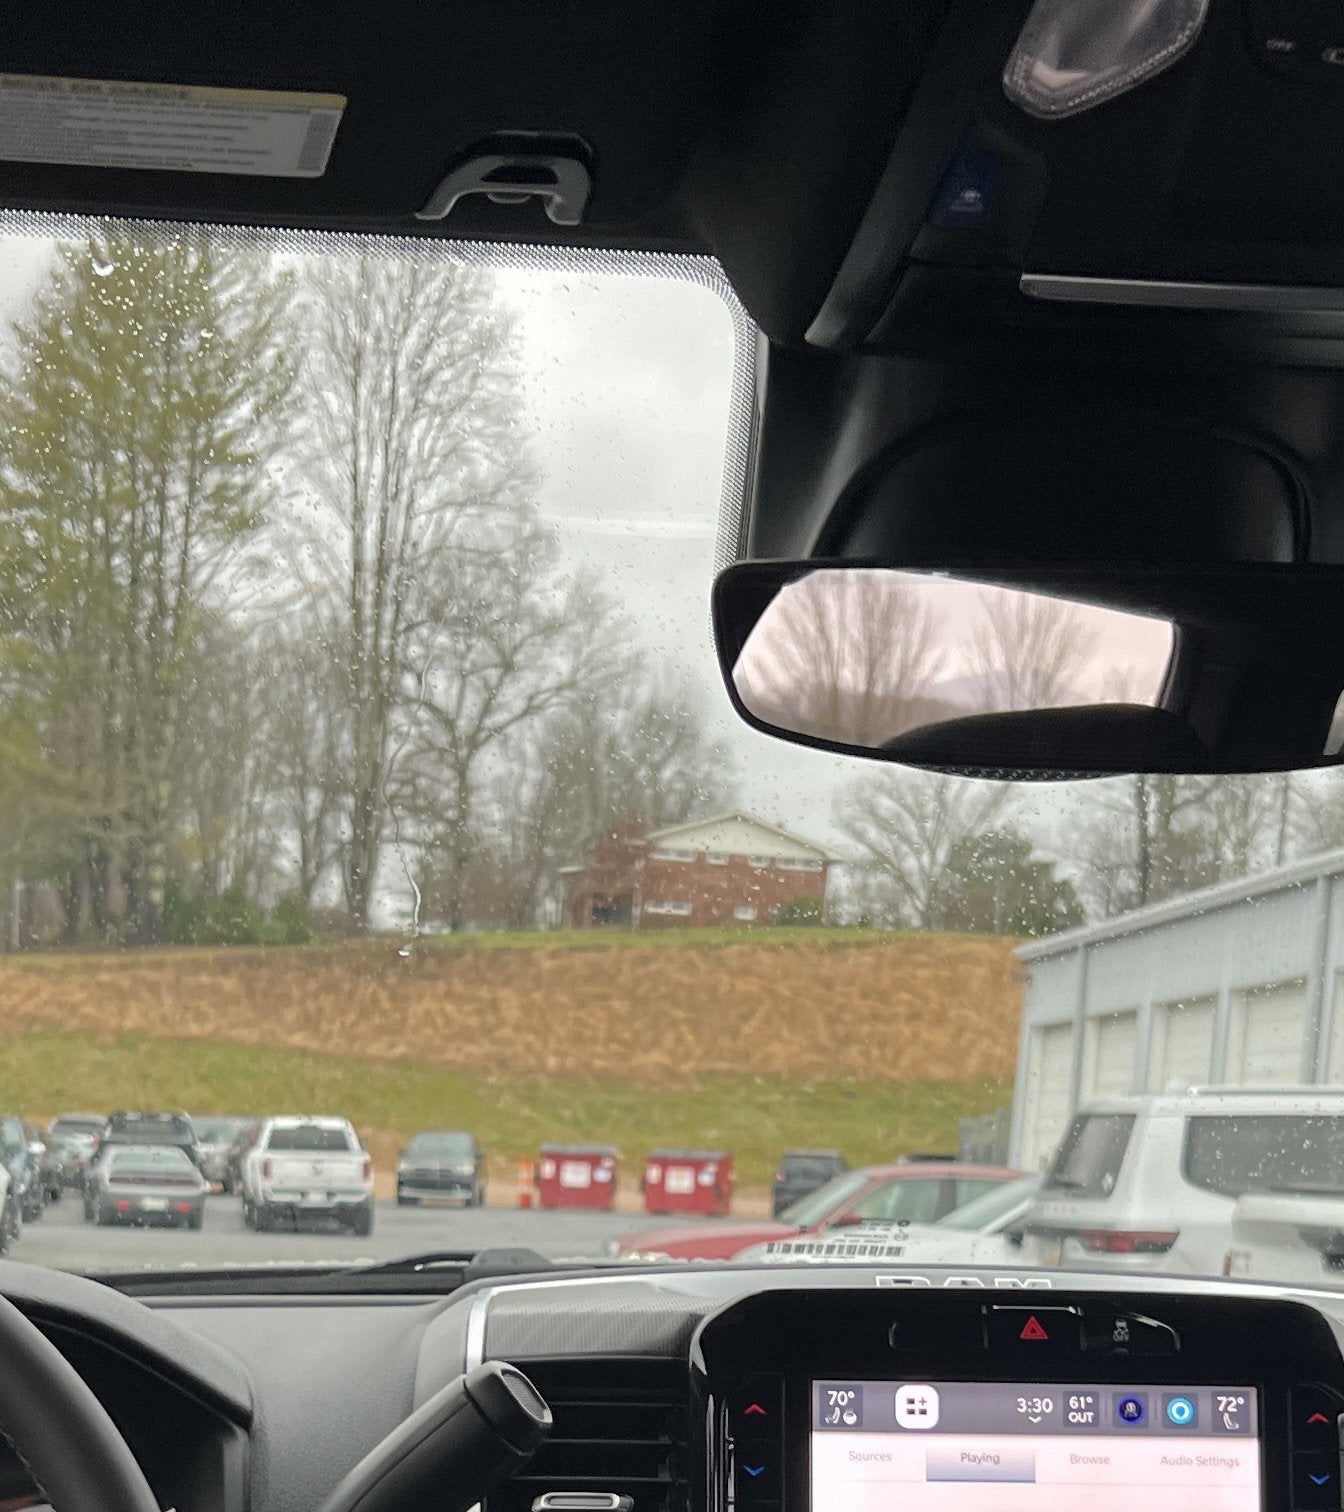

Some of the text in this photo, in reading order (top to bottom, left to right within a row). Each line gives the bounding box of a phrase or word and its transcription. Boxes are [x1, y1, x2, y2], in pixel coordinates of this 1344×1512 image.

[1017, 1398, 1053, 1413] 3:30
[1068, 1411, 1094, 1423] OUT
[848, 1450, 892, 1462] Sources
[960, 1452, 1000, 1465] Playing
[1070, 1454, 1110, 1465] Browse
[1160, 1455, 1239, 1468] Audio Settings
